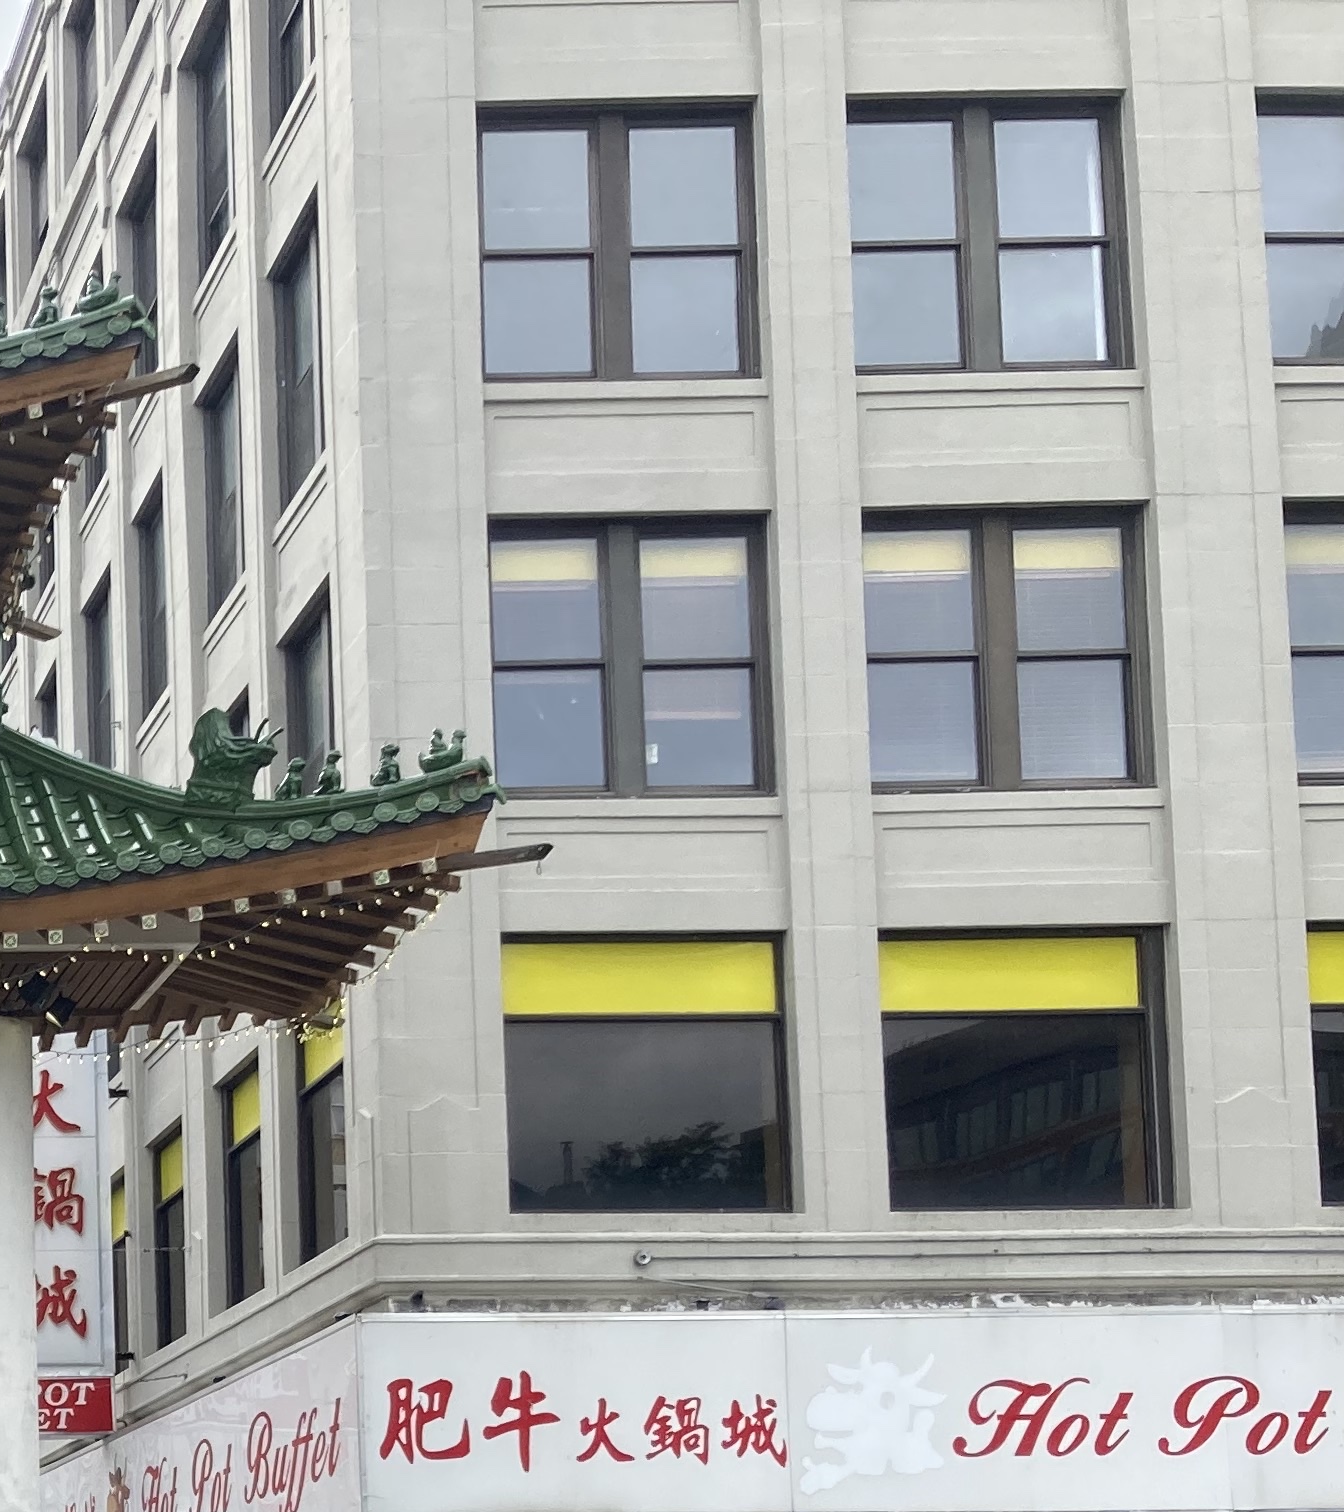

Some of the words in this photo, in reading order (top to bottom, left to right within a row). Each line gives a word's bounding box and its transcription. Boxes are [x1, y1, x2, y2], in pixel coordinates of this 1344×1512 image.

[38, 1382, 96, 1406] OT
[379, 1371, 789, 1470] 肥牛火鍋城
[952, 1376, 1134, 1458] Hot
[1158, 1375, 1333, 1458] Pot
